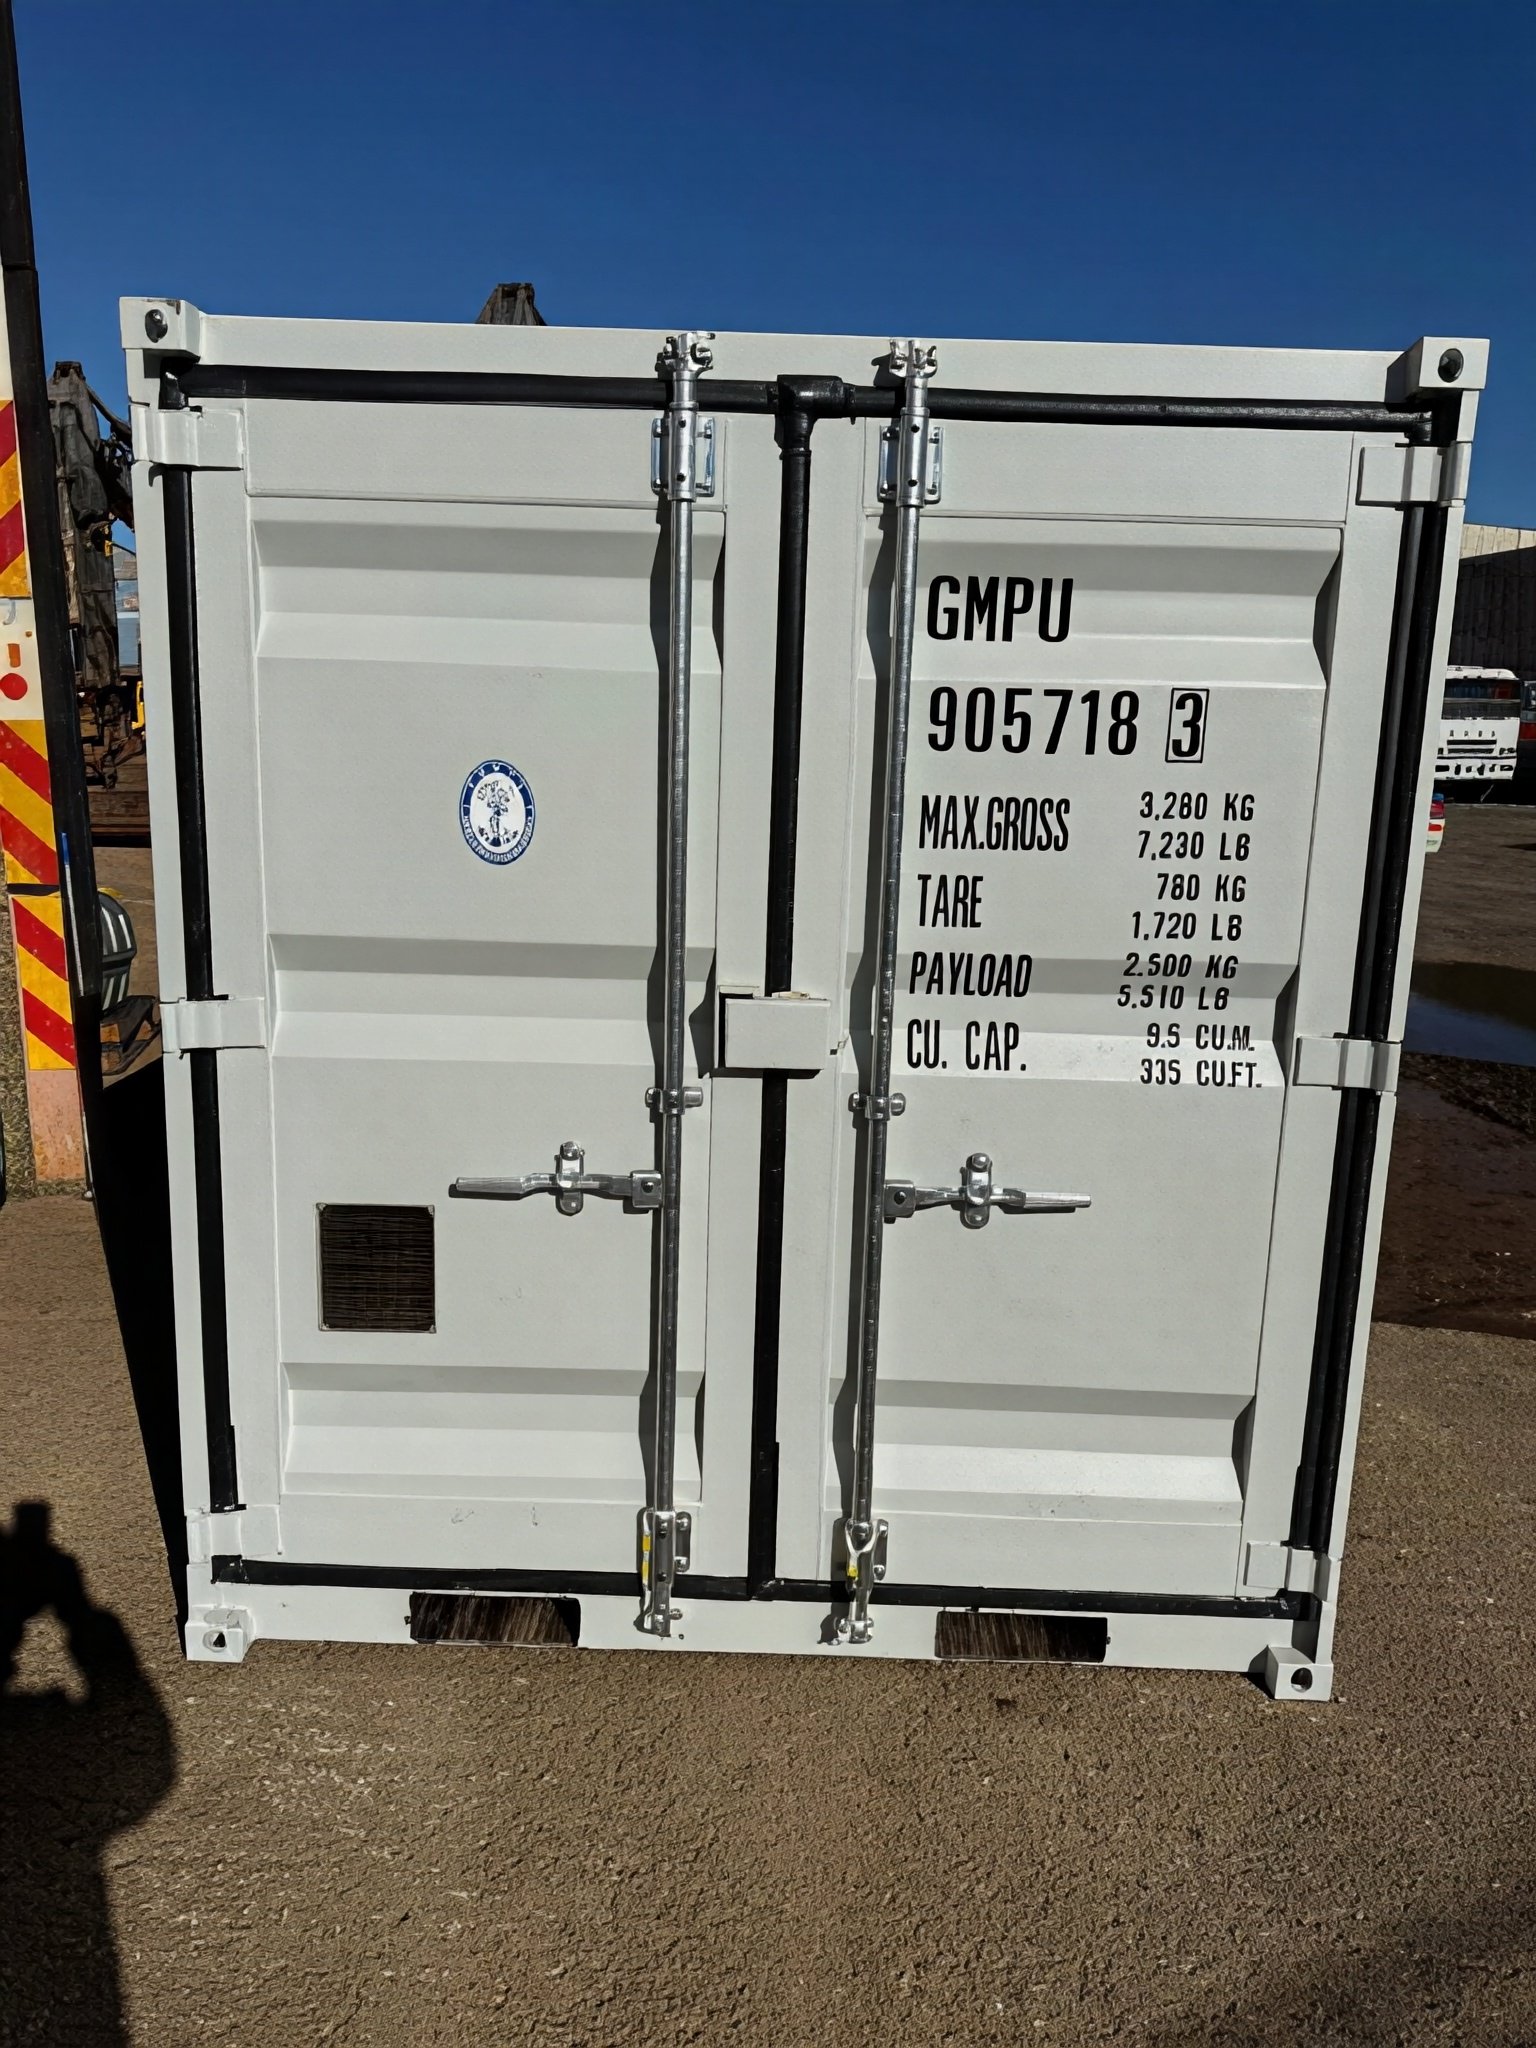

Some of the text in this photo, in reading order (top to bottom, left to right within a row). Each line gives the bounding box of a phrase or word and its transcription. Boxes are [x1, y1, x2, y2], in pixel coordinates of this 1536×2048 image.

[927, 575, 1074, 643] GMPU
[928, 687, 1203, 757] 905718 3
[1223, 793, 1255, 822] KG
[919, 795, 1071, 852] MAX.GROSS
[1219, 833, 1251, 862] LB
[917, 874, 984, 928] TARE
[1157, 873, 1247, 903] 780 KG
[1211, 914, 1243, 942] LB
[909, 952, 1033, 998] PAYLOAD
[1205, 955, 1239, 979] KG
[1197, 987, 1230, 1011] LB
[907, 1019, 1028, 1071] CU. CAP.
[1146, 1023, 1181, 1049] 9.5
[1140, 1059, 1181, 1086] 335
